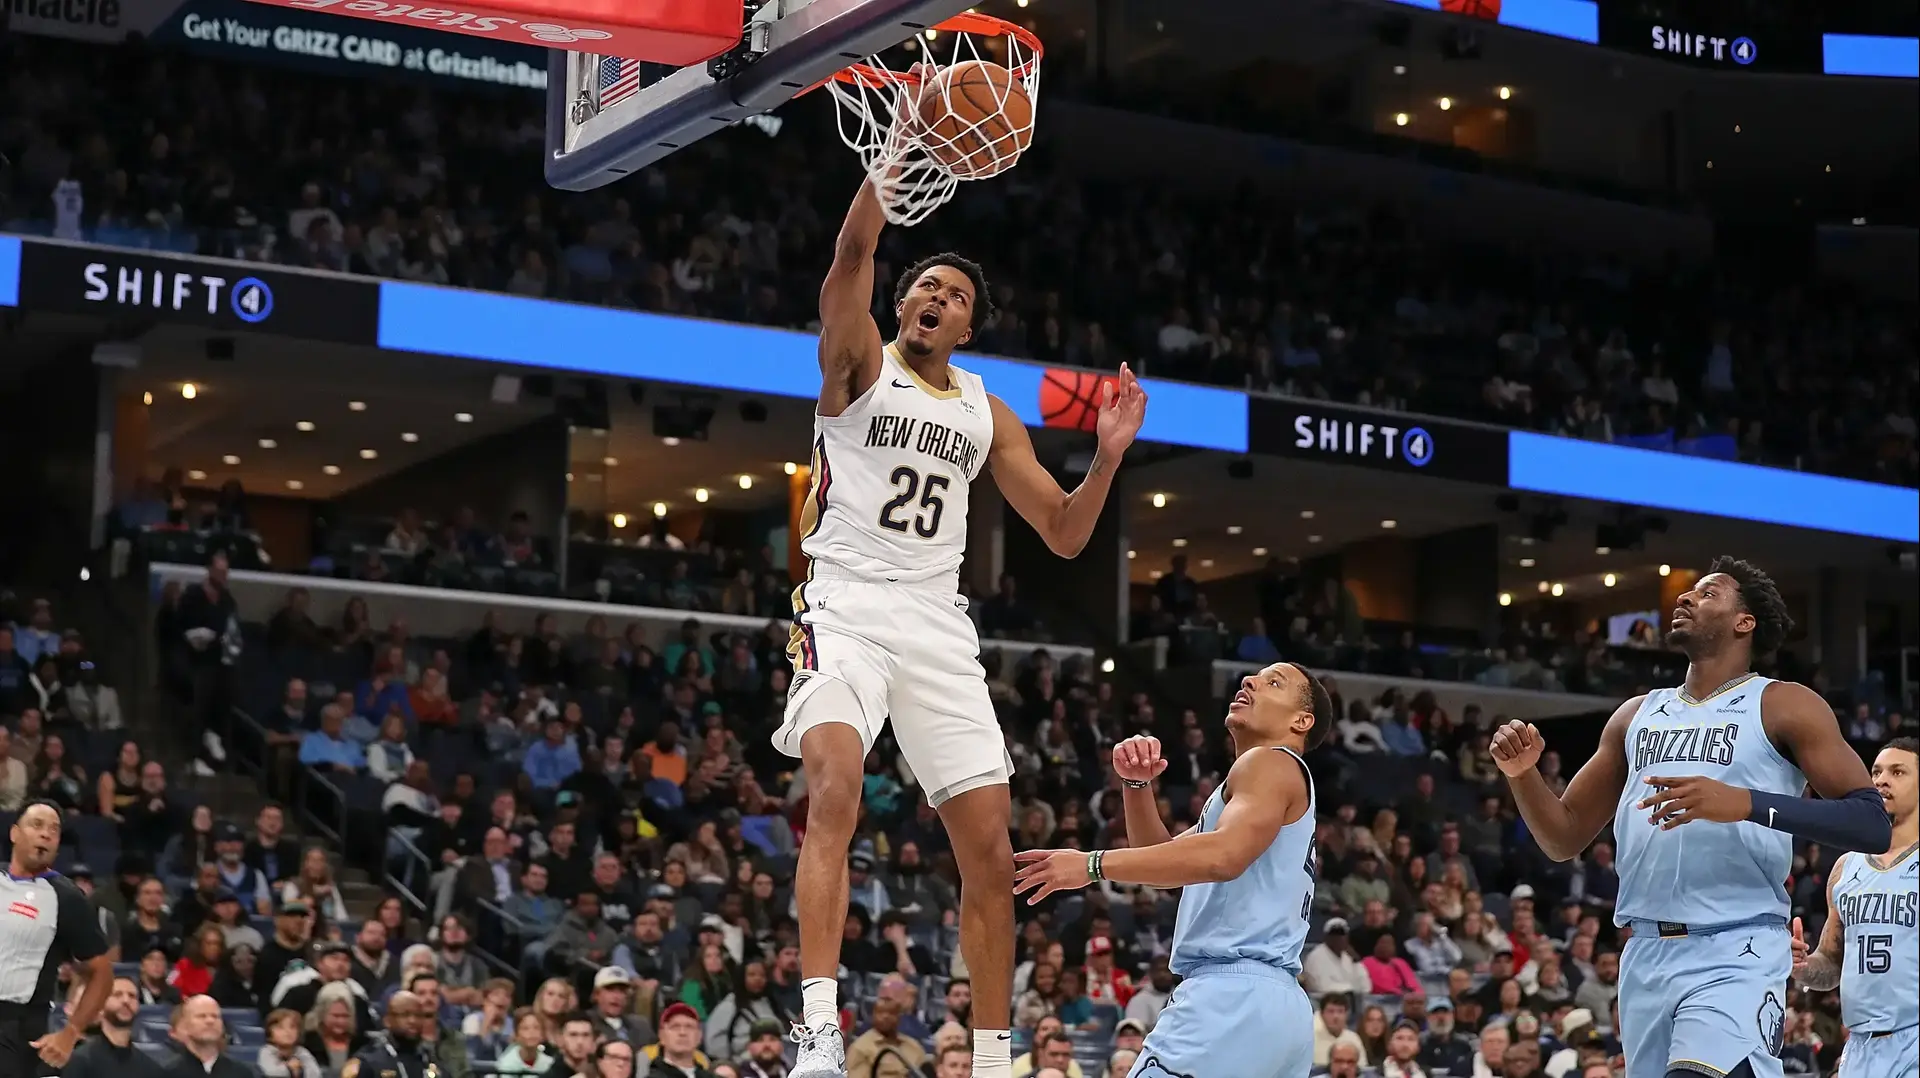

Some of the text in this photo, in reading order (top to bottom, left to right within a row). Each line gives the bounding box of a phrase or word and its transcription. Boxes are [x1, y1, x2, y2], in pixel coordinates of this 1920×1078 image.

[344, 0, 518, 31] State
[183, 13, 221, 41] Get
[224, 18, 270, 48] Your
[273, 26, 340, 58] GRIZZ
[341, 35, 402, 67] CARD
[403, 47, 425, 71] at
[864, 415, 978, 480] NEW ORLEANS
[877, 464, 952, 540] 25
[1635, 723, 1739, 772] GRIZZLIES
[1839, 891, 1918, 928] GRIZZLIES
[1857, 934, 1893, 974] 15
